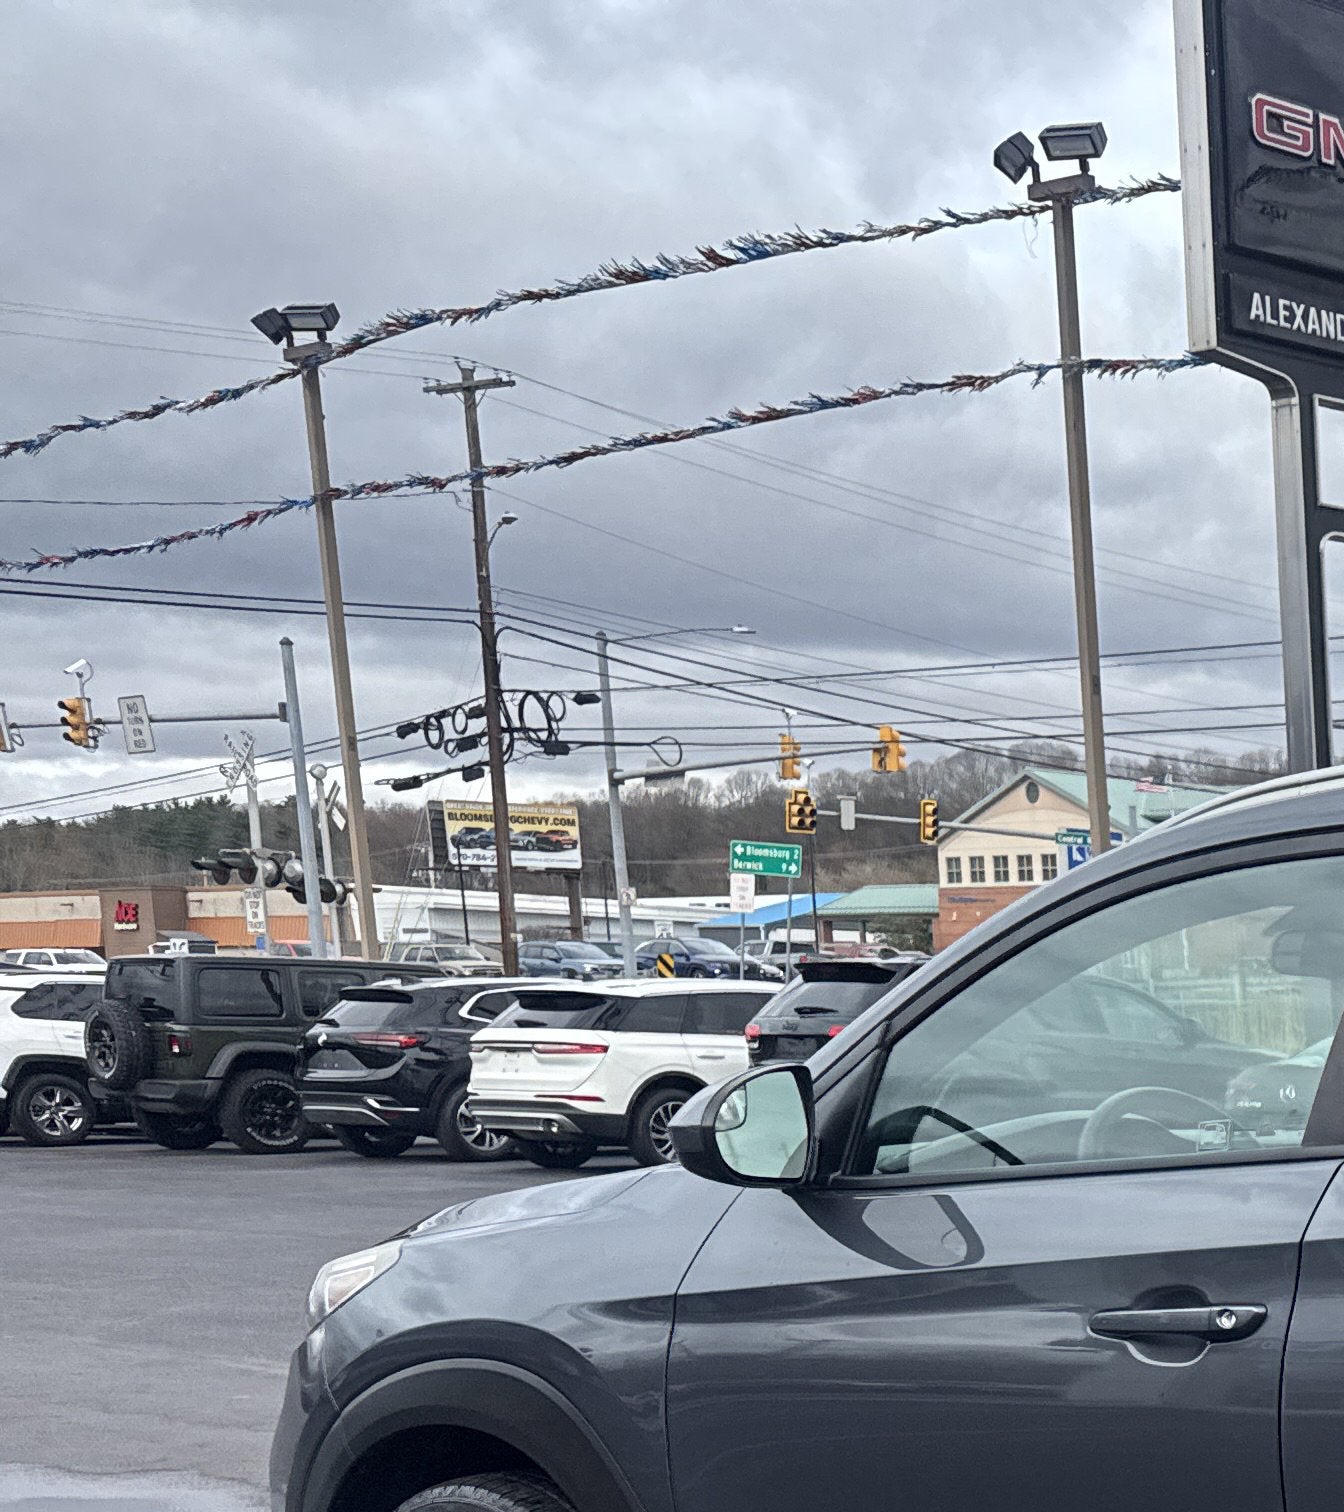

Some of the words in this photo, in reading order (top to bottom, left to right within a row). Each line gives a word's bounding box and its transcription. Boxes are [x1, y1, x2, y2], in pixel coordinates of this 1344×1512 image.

[126, 701, 139, 715] NO
[448, 811, 577, 828] BLOOMSGCHEVY.COM
[746, 845, 790, 860] Bloomsburg
[793, 848, 799, 860] 2
[733, 858, 763, 871] Berwick
[781, 862, 787, 873] 9
[114, 901, 138, 922] ACE
